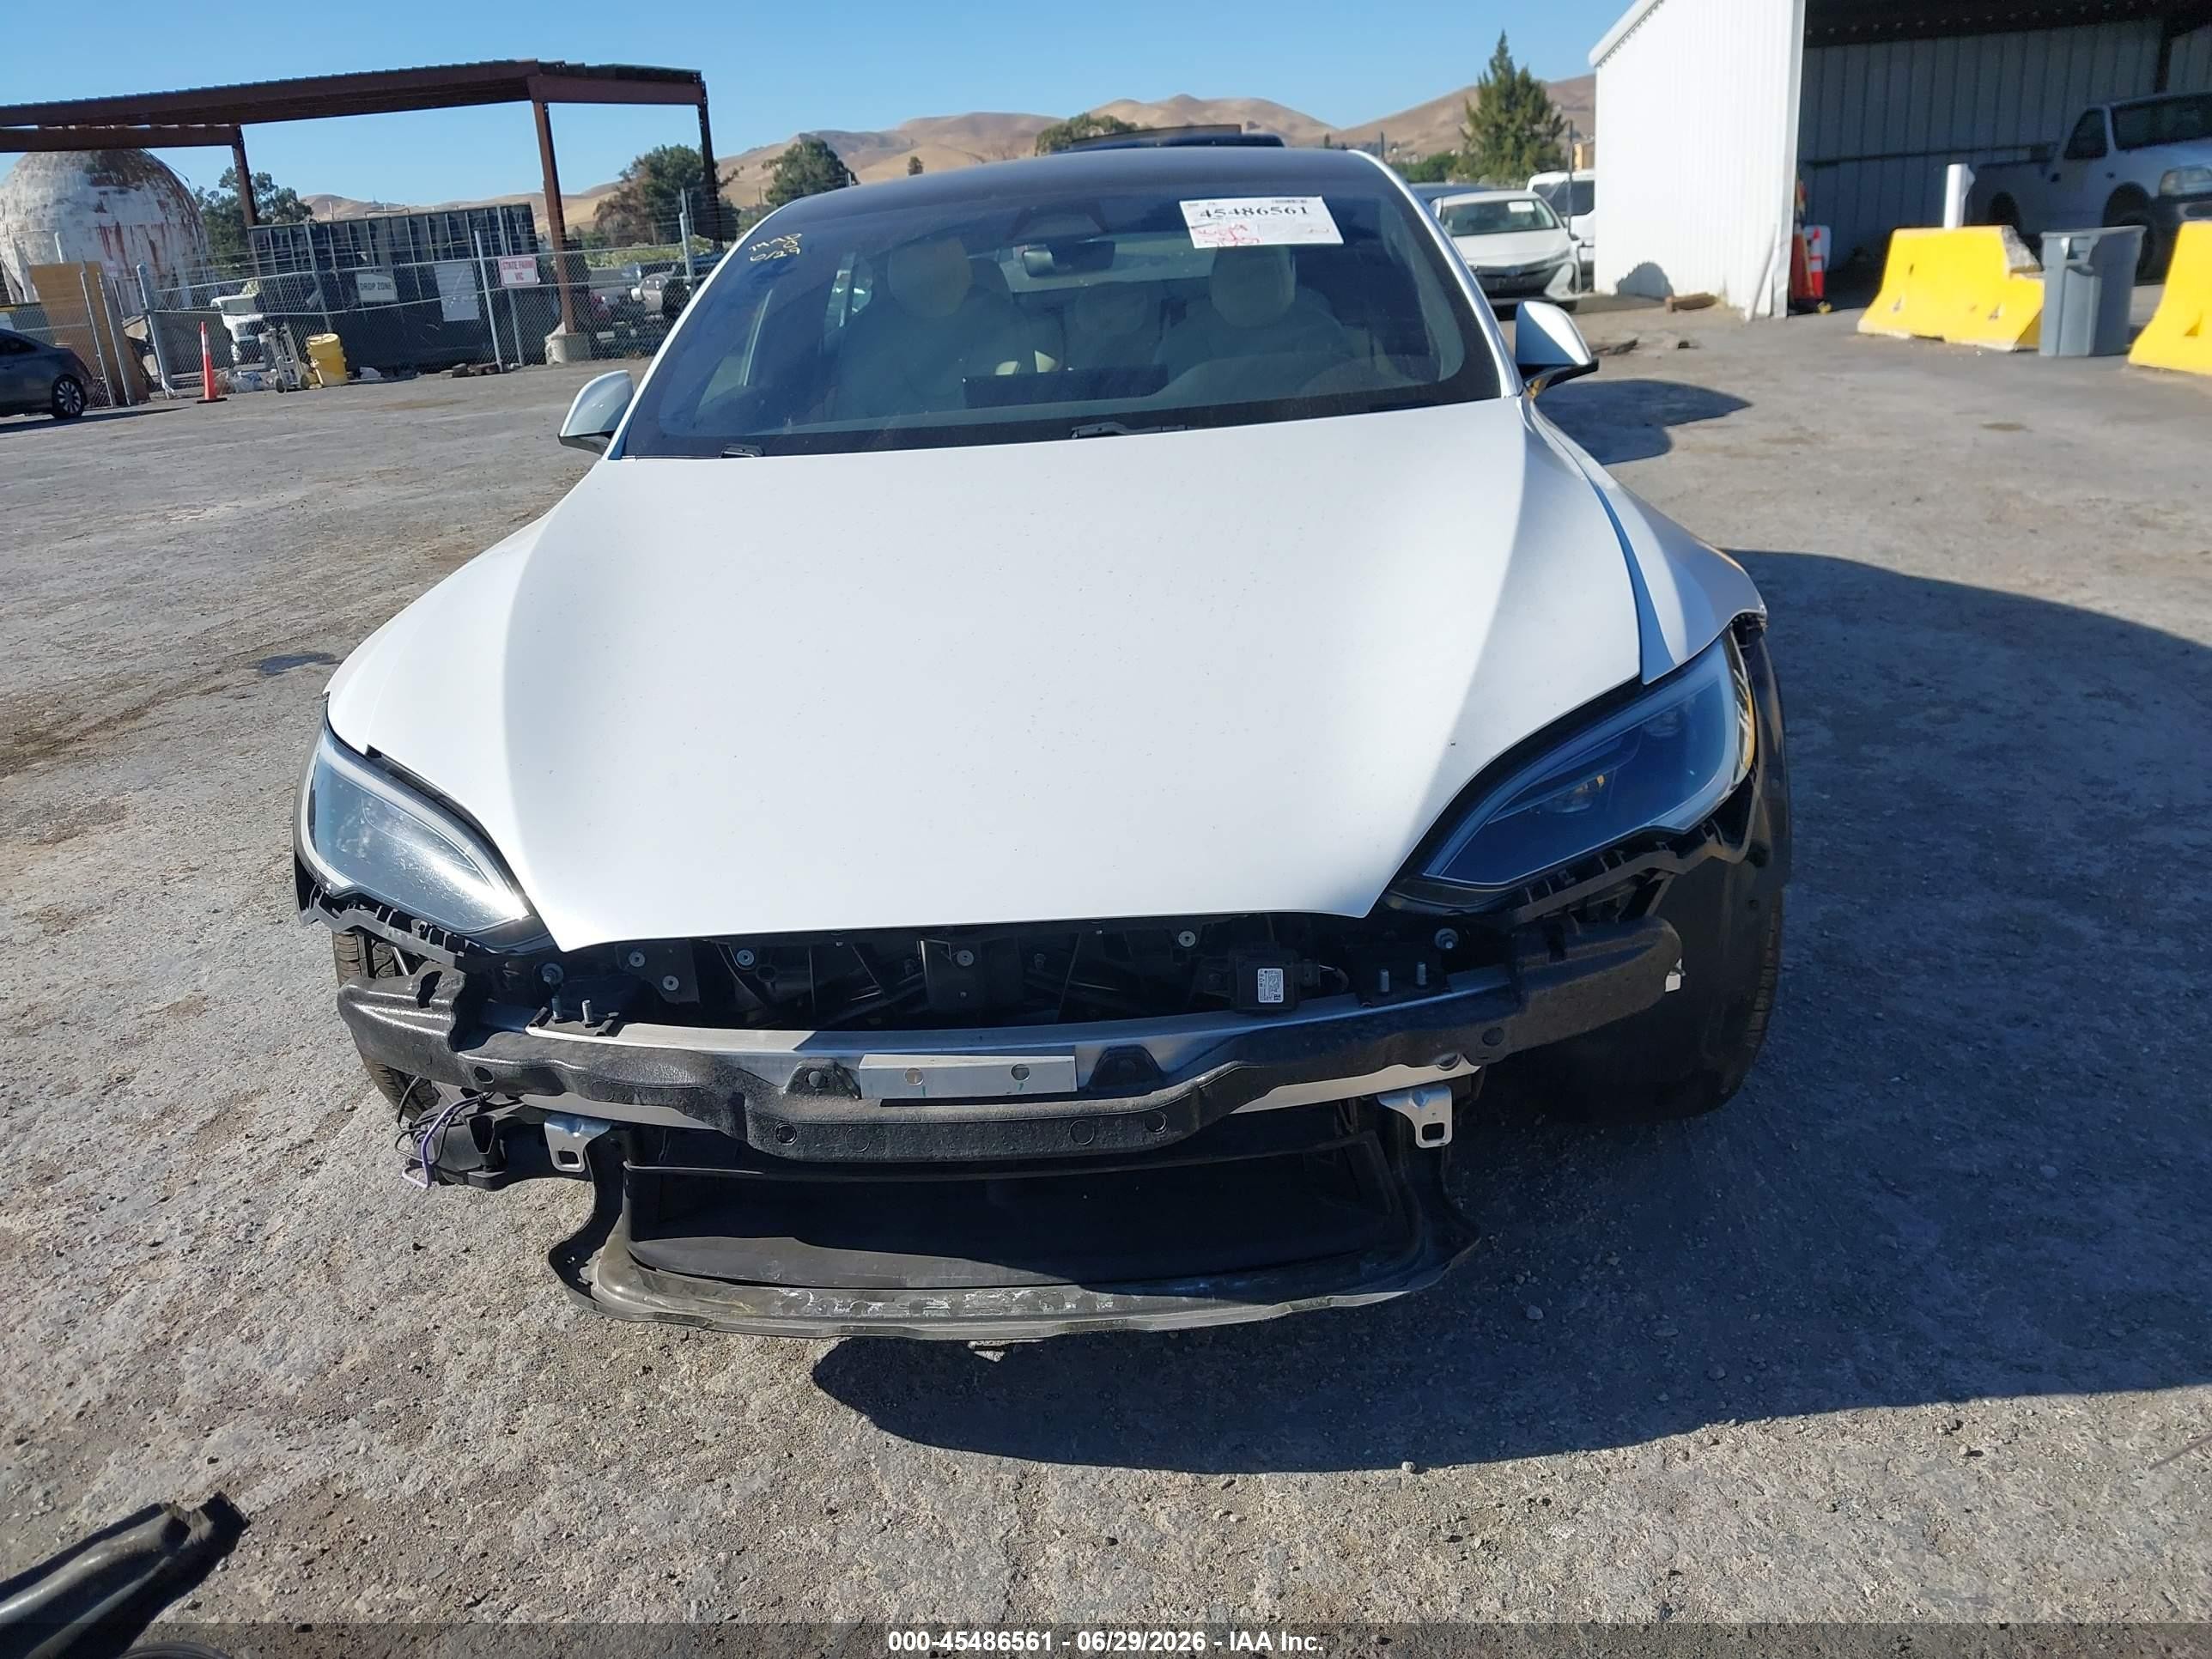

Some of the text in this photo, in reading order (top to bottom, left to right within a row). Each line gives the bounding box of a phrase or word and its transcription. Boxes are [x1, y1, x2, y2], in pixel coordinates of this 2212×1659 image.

[1200, 206, 1310, 218] 45486561
[749, 246, 801, 262] 6/29
[359, 281, 392, 291] DROP ZONE
